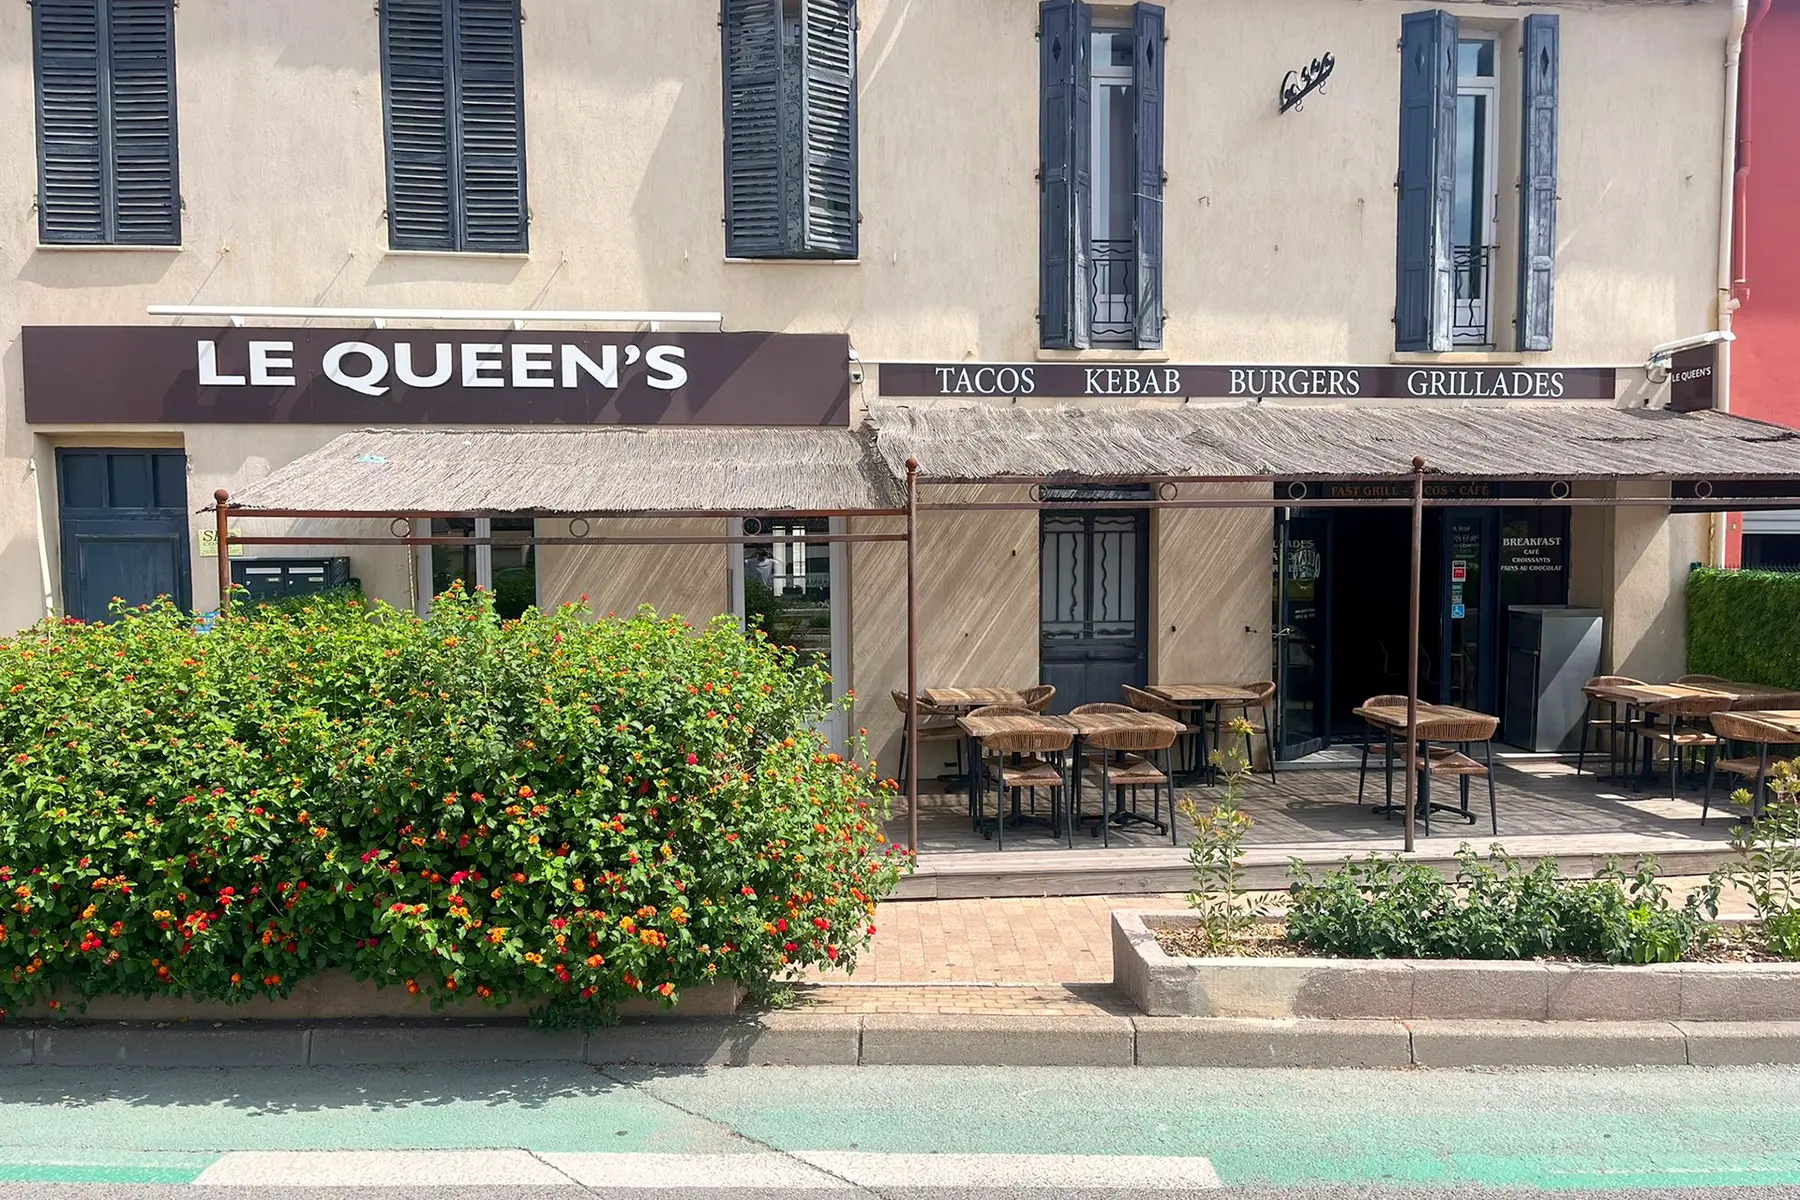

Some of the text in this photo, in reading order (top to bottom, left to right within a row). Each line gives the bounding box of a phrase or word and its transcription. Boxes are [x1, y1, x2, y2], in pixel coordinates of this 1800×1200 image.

[197, 340, 296, 386] LE
[935, 367, 1565, 398] TACOS KEBAB BURGERS GRILLADES
[1672, 373, 1680, 382] LE
[1331, 486, 1361, 496] FAST
[1364, 486, 1398, 496] GRILL
[1503, 537, 1562, 546] BREAKFAST
